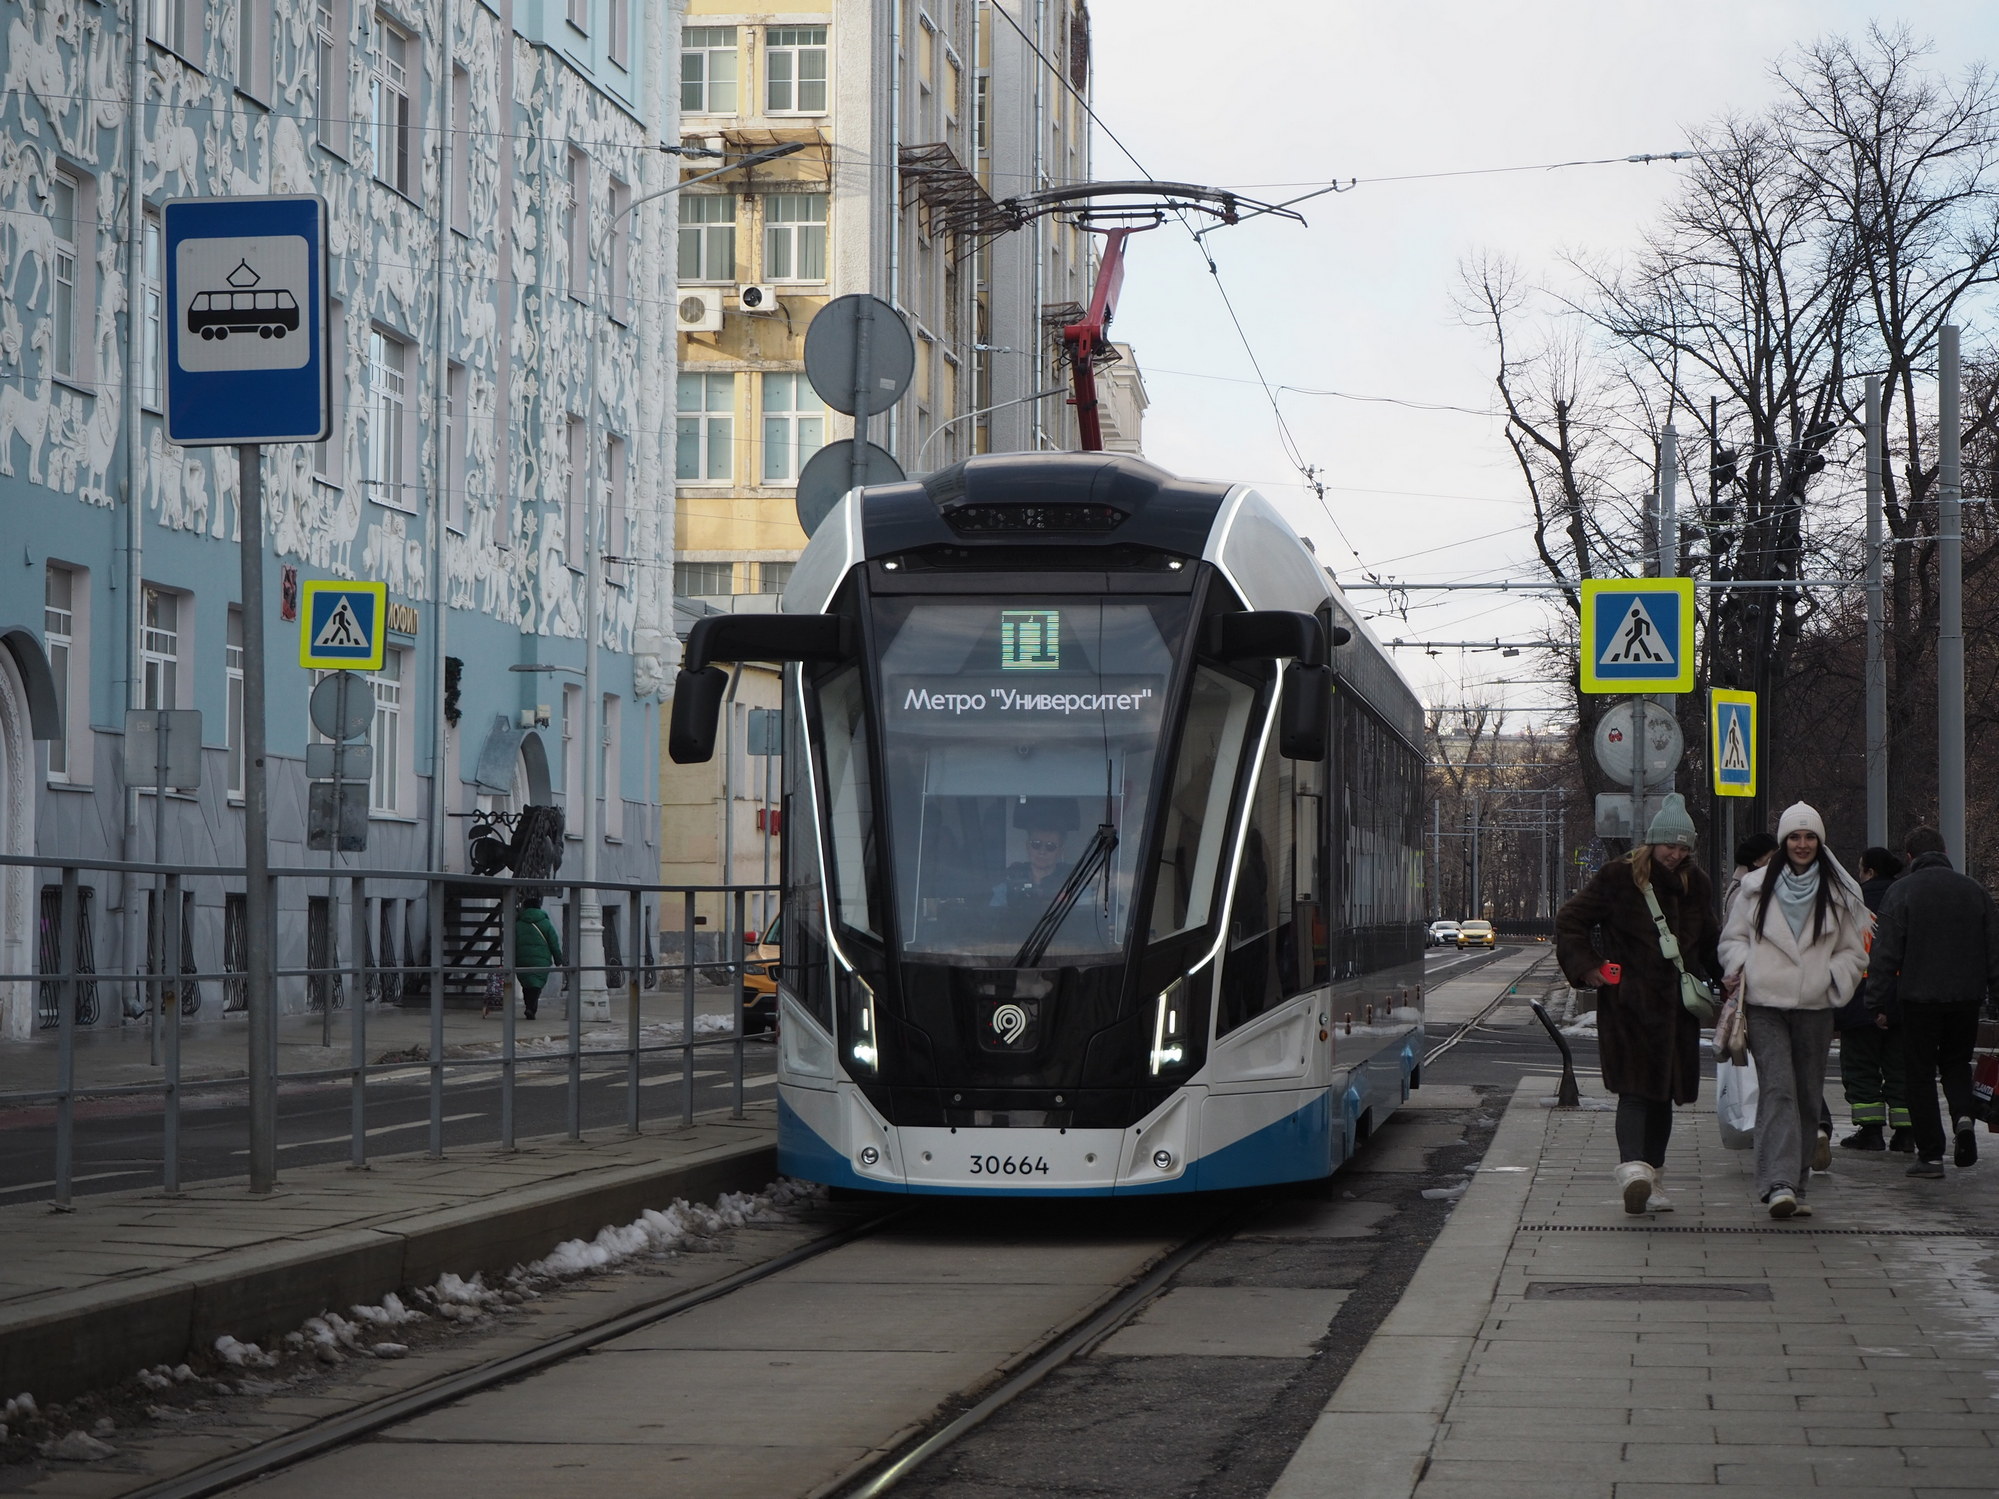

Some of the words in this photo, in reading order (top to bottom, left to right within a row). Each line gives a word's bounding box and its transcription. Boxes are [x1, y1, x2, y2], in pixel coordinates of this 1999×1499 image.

[904, 688, 986, 715] Метро
[991, 688, 1152, 715] "Университет"
[970, 1155, 1050, 1175] 30664
